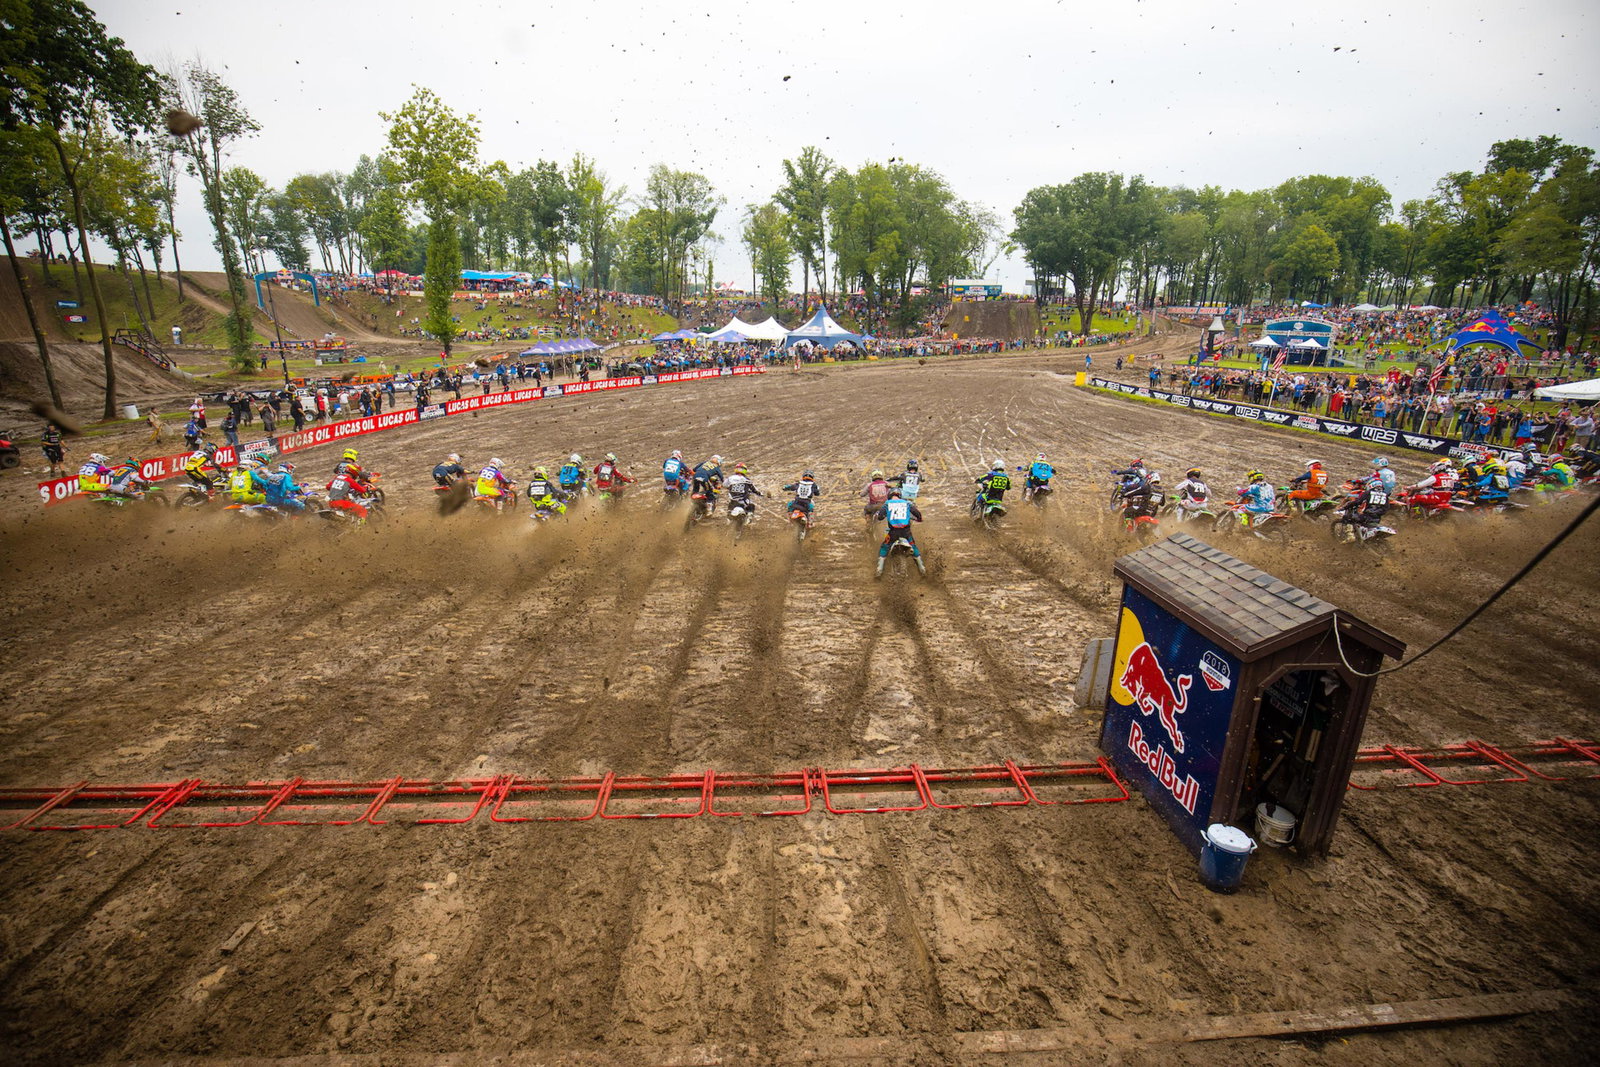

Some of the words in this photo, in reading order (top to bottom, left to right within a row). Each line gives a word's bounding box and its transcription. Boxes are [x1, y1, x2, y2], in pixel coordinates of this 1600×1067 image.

[514, 391, 532, 400] LUCAS
[532, 389, 542, 398] OIL
[565, 384, 582, 393] LUCAS
[583, 382, 592, 391] OIL
[448, 401, 468, 412] LUCAS
[470, 398, 480, 408] OIL
[482, 396, 501, 405] LUCAS
[502, 394, 512, 402] OIL
[378, 413, 404, 428] LUCAS
[405, 410, 416, 422] OIL
[1235, 405, 1260, 420] WPS
[335, 422, 360, 436] LUCAS
[362, 420, 375, 430] OIL
[1361, 426, 1398, 444] WPS
[282, 432, 314, 450] LUCAS
[316, 428, 330, 440] OIL
[1402, 434, 1446, 449] FLY
[215, 449, 234, 464] OIL
[79, 466, 96, 476] 28
[143, 462, 166, 478] OIL
[480, 470, 496, 480] 26
[54, 478, 81, 500] OIL
[1206, 654, 1227, 675] 2018
